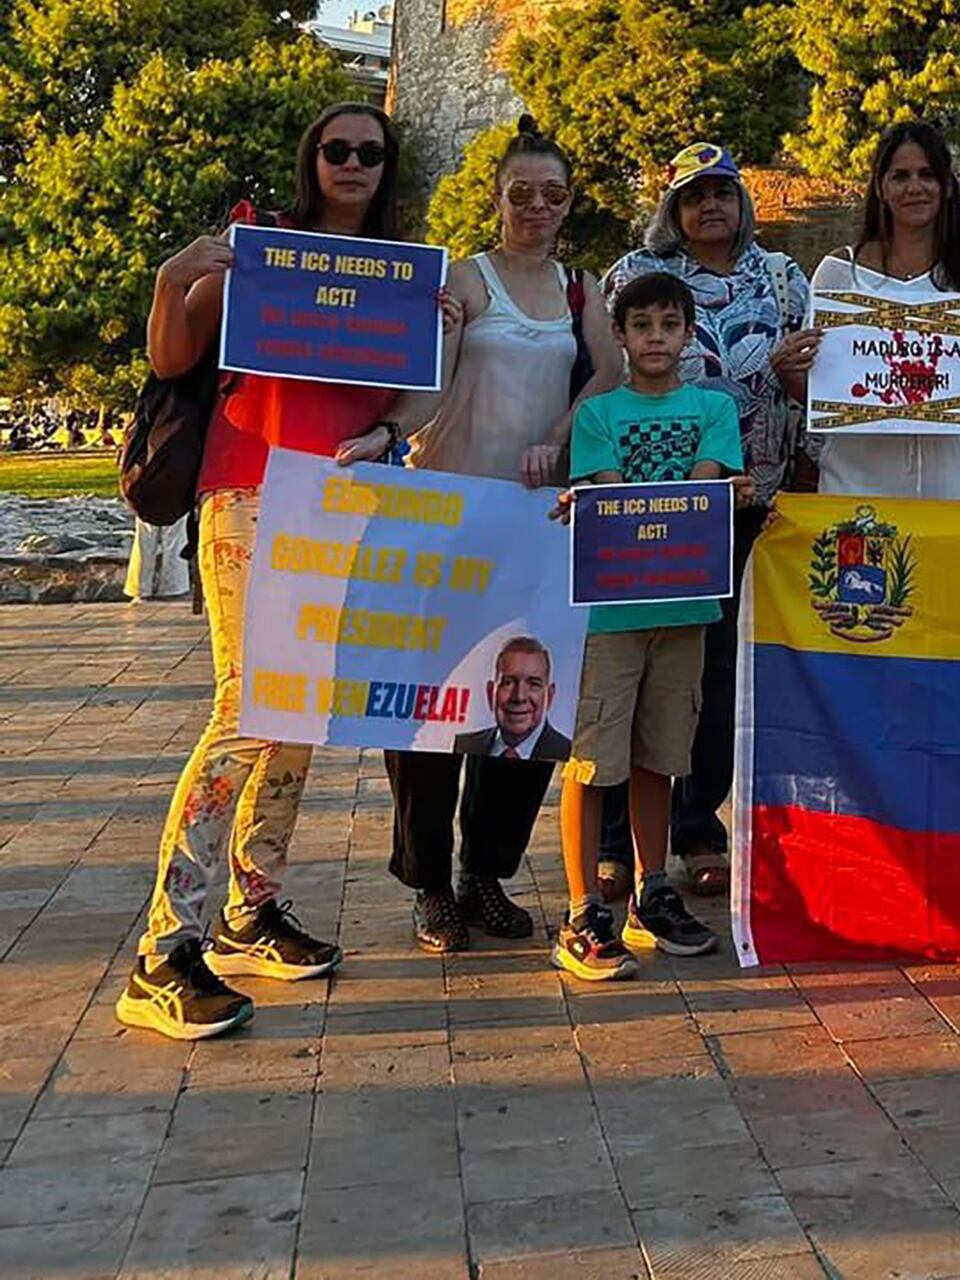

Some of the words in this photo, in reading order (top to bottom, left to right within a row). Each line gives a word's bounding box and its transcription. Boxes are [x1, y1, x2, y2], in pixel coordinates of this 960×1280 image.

[264, 247, 296, 269] THE
[301, 251, 330, 272] ICC
[335, 255, 387, 278] NEEDS
[391, 261, 413, 281] TO
[315, 285, 356, 308] ACT!
[865, 372, 949, 390] MURDERER!
[596, 500, 620, 516] THE
[623, 499, 646, 514] ICC
[649, 496, 688, 513] NEEDS
[691, 495, 709, 511] TO
[637, 524, 668, 541] ACT!
[316, 677, 471, 724] VENEZUELA!
